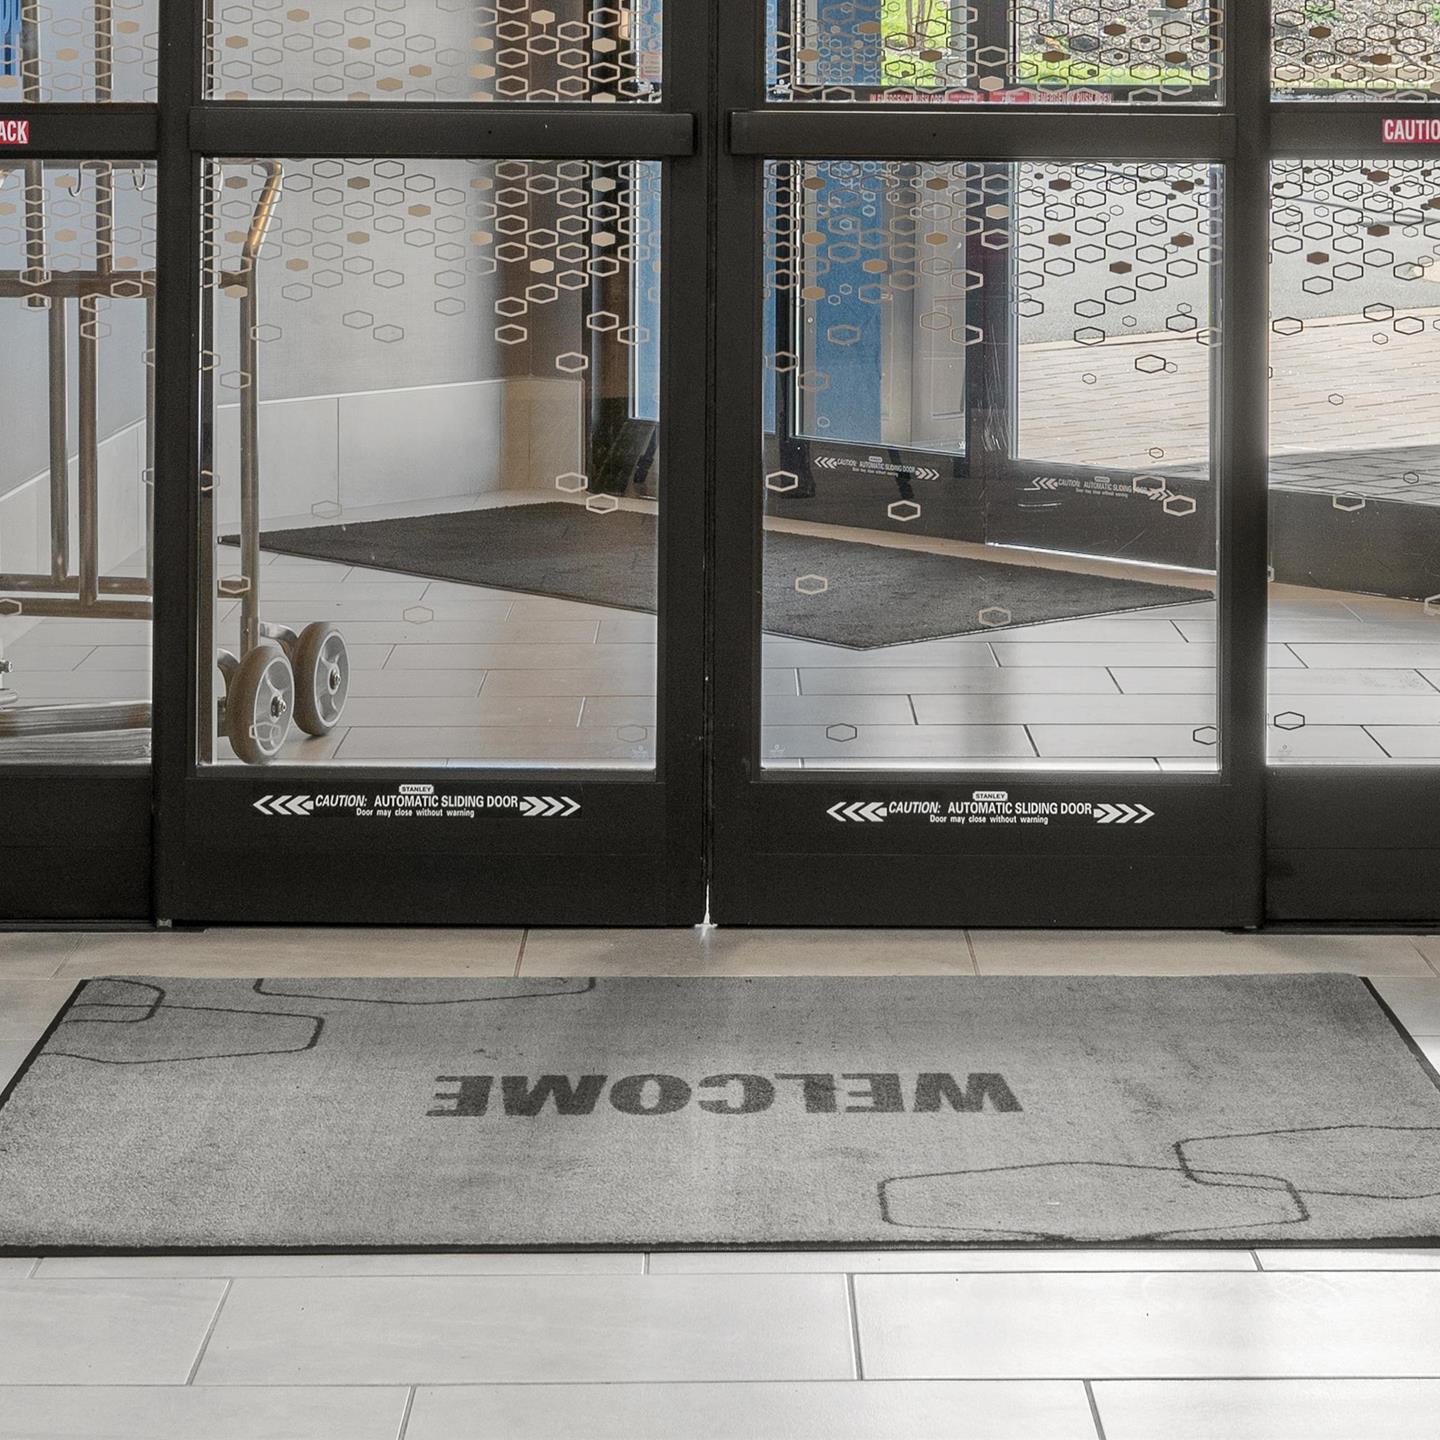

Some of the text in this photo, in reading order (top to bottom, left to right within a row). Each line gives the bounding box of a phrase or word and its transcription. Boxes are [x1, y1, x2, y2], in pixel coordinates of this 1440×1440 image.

[401, 785, 432, 793] STANLEY
[315, 794, 519, 808] CAUTION: AUTOMATIC SLIDING DOOR
[356, 808, 475, 818] Door may close without warning
[888, 801, 1092, 815] CAUTION: AUTOMATIC SLIDING DOOR
[929, 814, 1049, 825] Door may close without warning
[425, 1072, 1025, 1117] WELCOME
